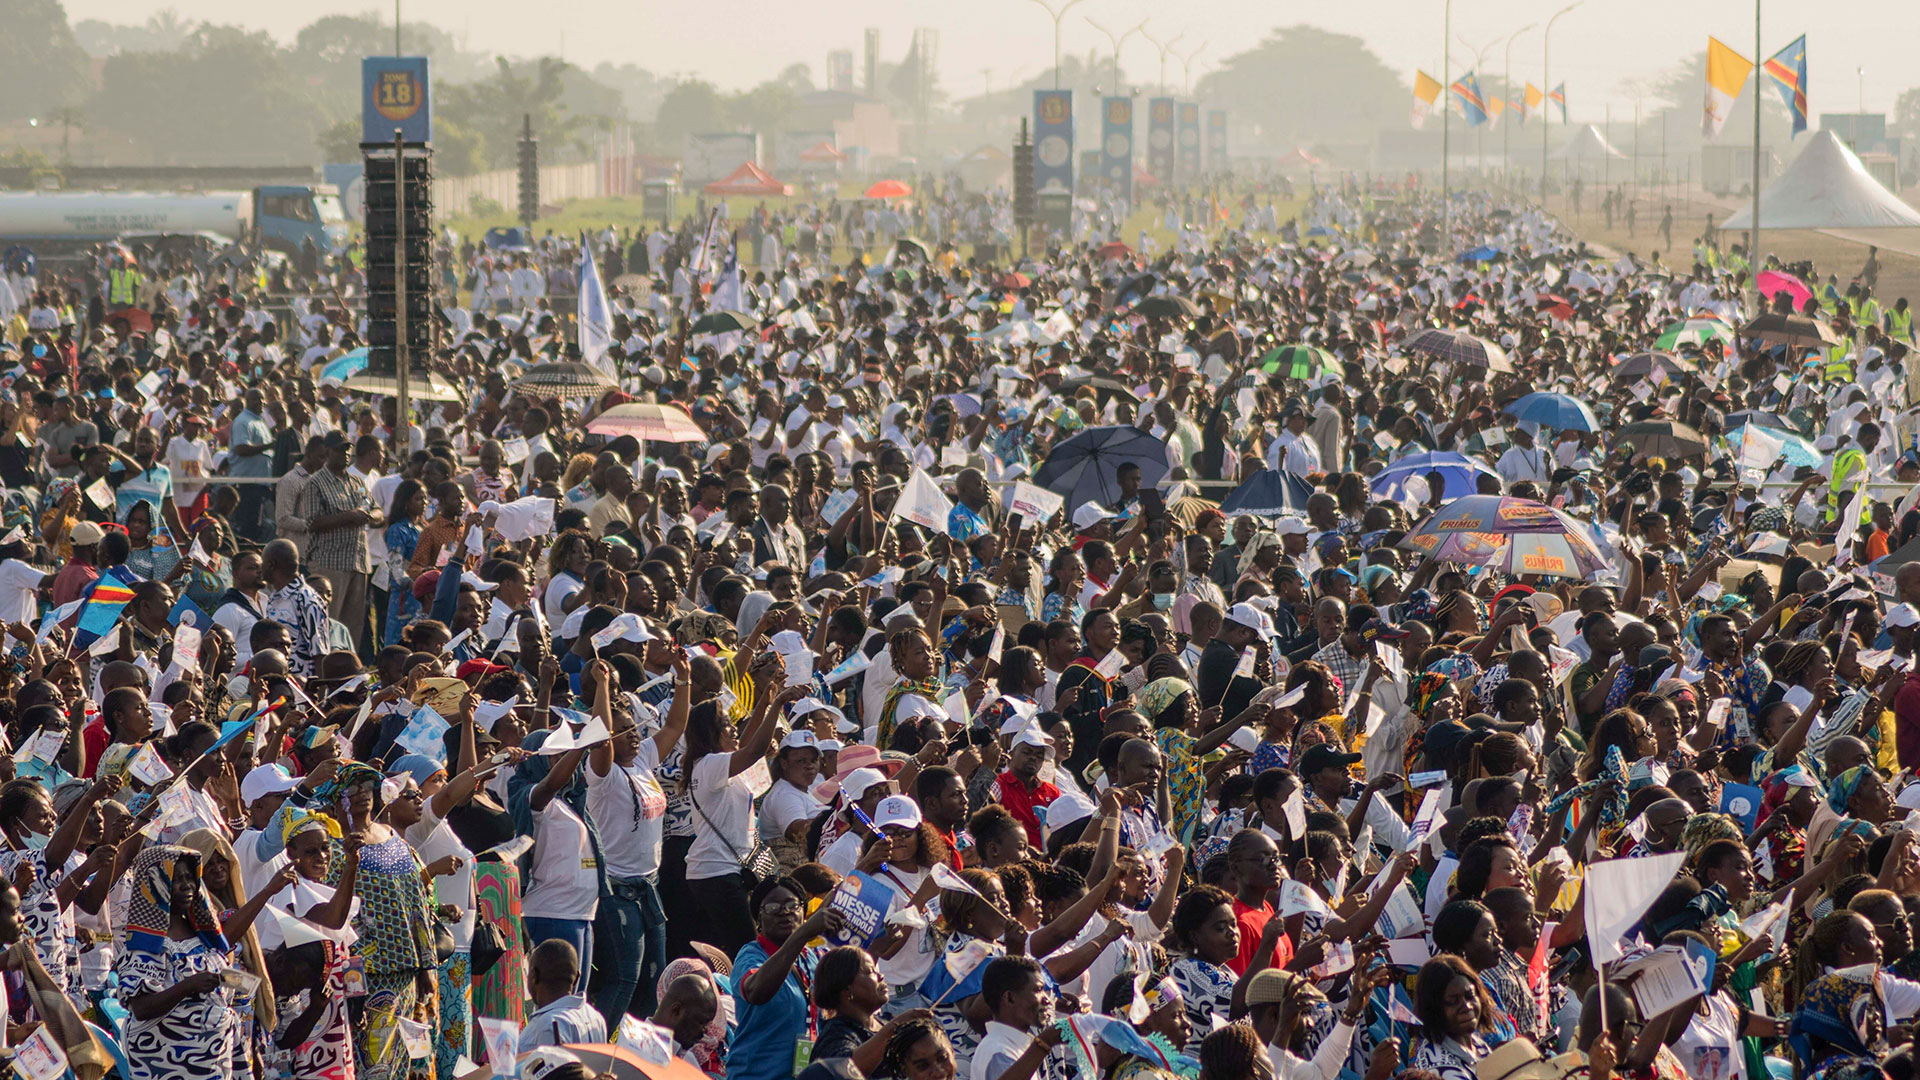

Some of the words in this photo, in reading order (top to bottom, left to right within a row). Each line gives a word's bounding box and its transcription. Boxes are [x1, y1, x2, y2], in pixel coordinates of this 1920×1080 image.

[383, 73, 408, 82] ZONE
[382, 83, 411, 104] 18
[1440, 520, 1480, 529] PRIMUS
[1363, 628, 1377, 638] GOLD
[834, 890, 880, 926] MESSE
[852, 914, 874, 935] NDOLO
